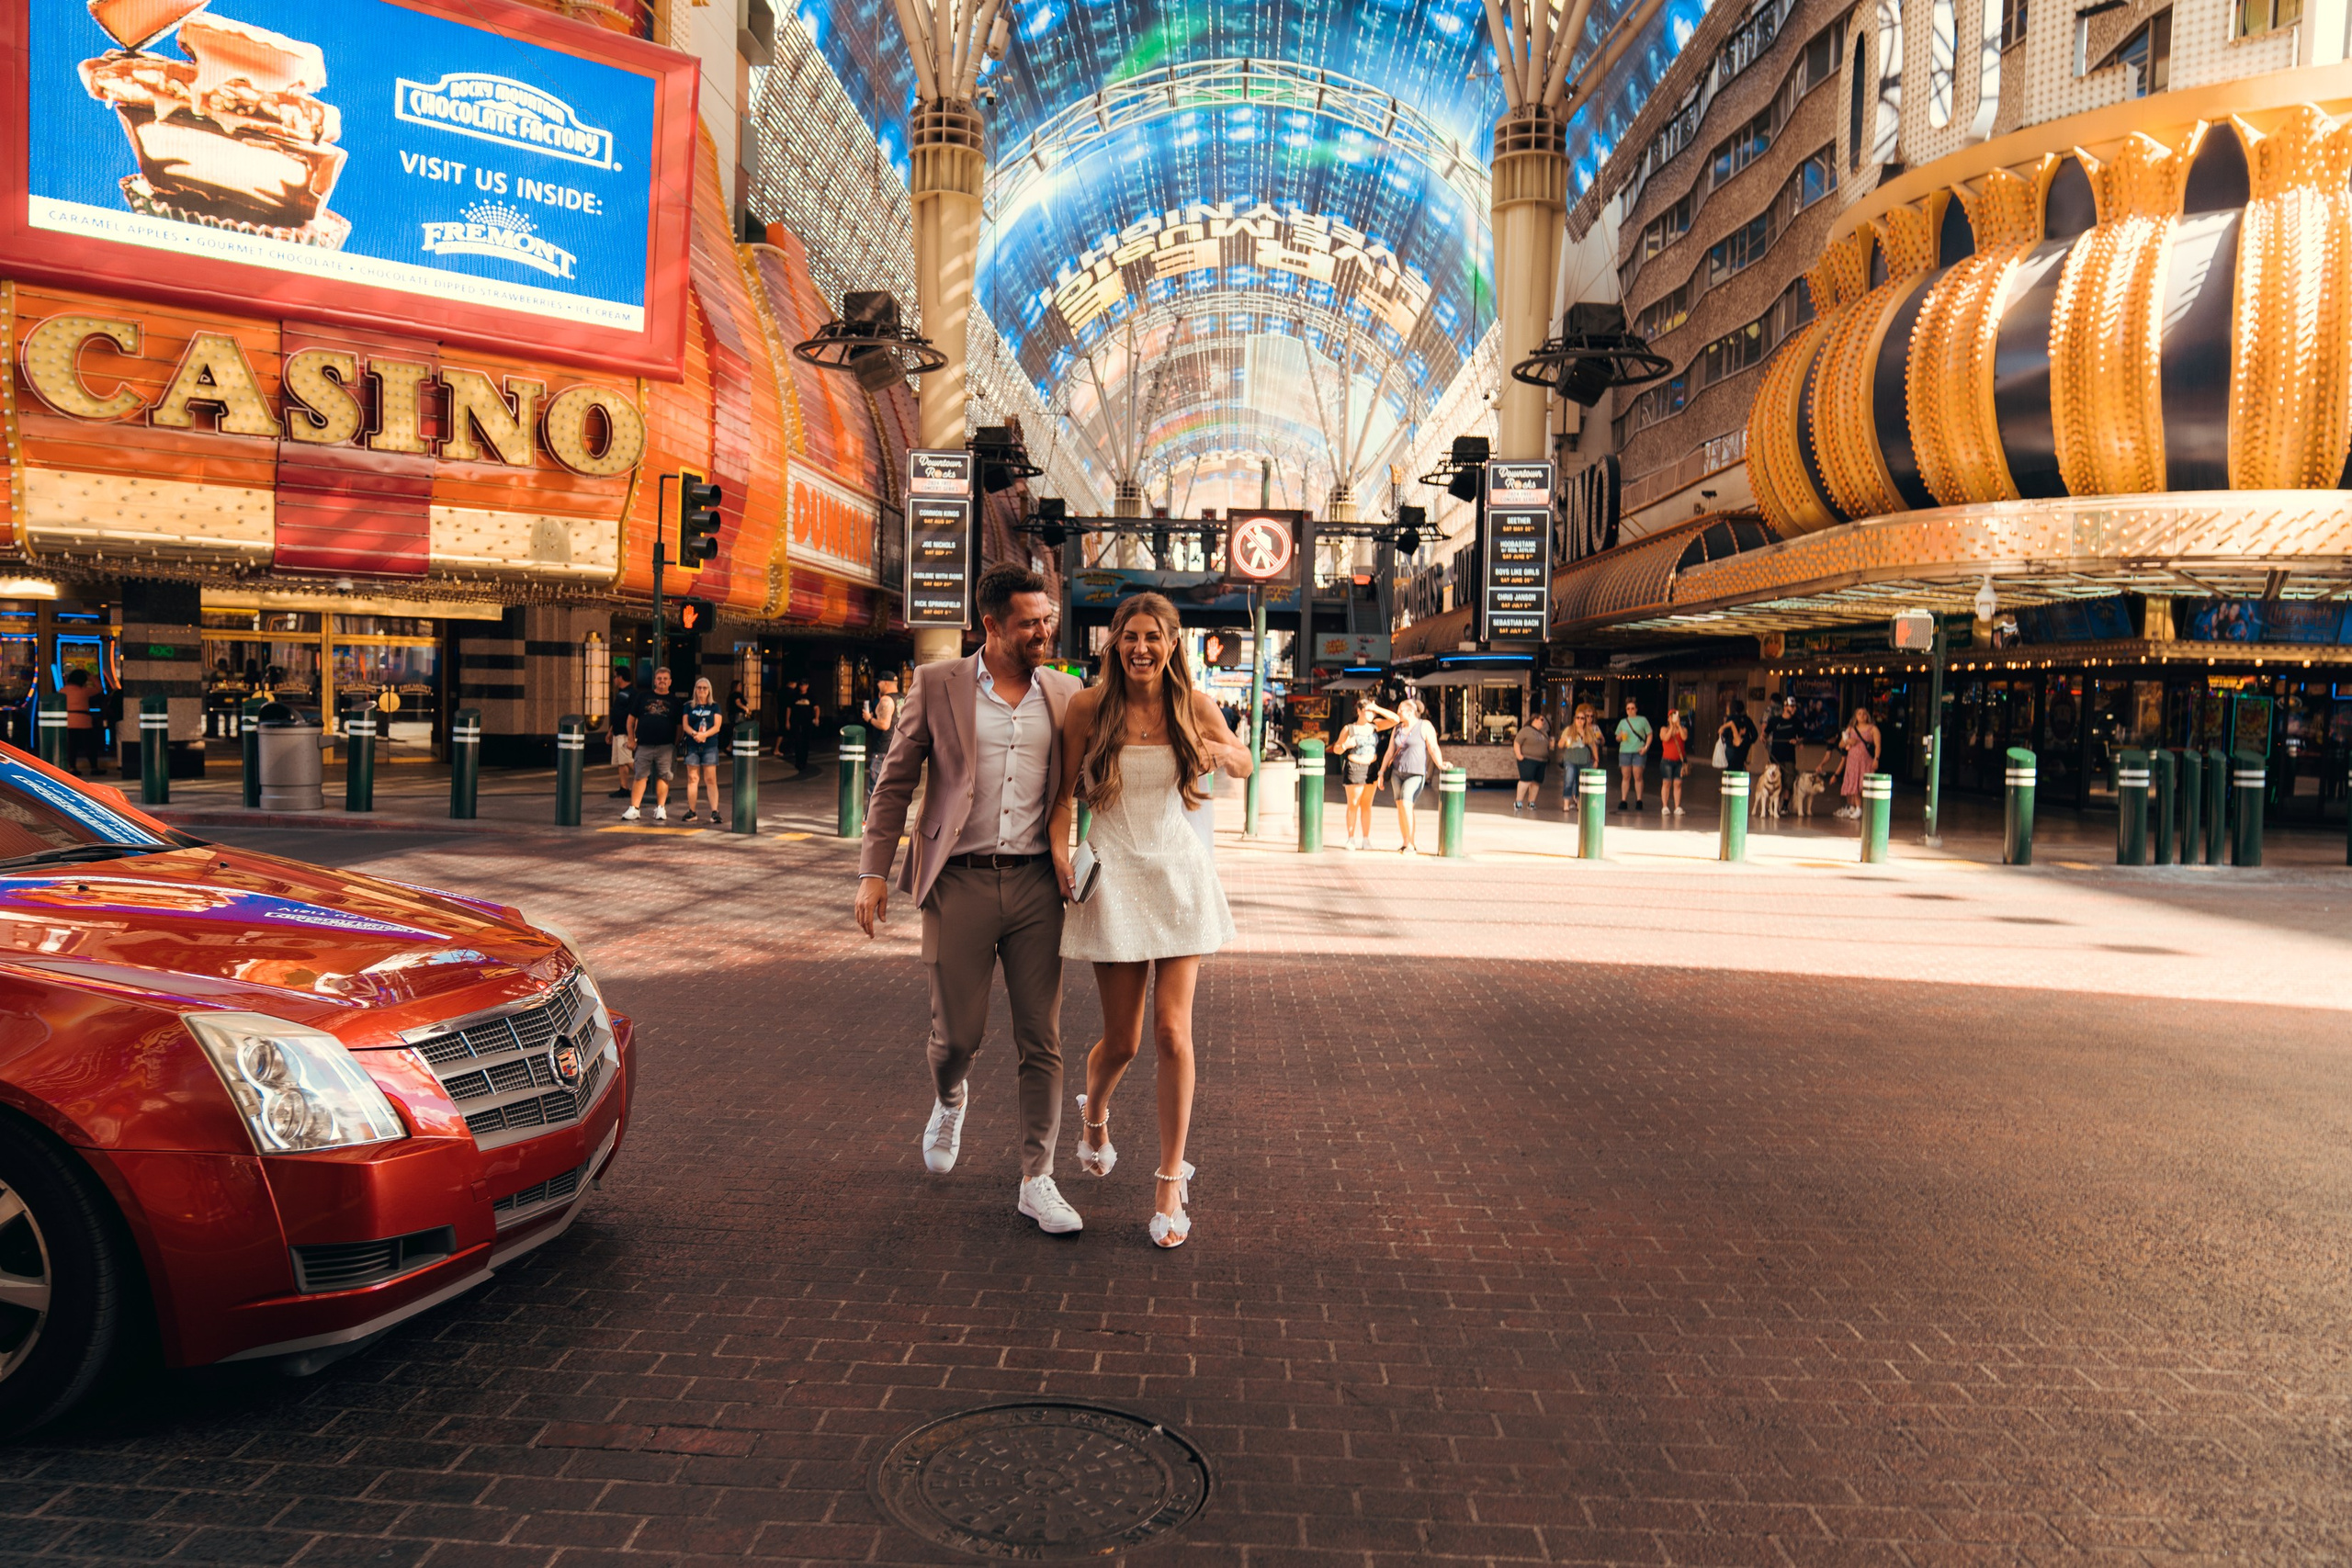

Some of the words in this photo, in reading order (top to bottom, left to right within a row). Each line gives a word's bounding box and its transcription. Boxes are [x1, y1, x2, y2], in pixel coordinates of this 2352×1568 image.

[450, 80, 493, 98] ROCKY
[495, 84, 565, 126] MOUNTAIN
[410, 90, 517, 136] CHOCOLATE
[520, 117, 599, 158] FACTORY
[399, 150, 467, 185] VISIT
[475, 167, 508, 195] US
[516, 177, 603, 216] INSIDE:
[422, 220, 577, 280] FREMONT
[48, 209, 120, 232] CARAMEL
[127, 223, 179, 242] APPLES
[196, 236, 265, 257] GOURMET
[268, 249, 344, 272] CHOCOLATE
[359, 265, 429, 287] CHOCOLATE
[434, 278, 476, 295] DIPPED
[480, 286, 563, 310] STRAWBERRIES
[575, 304, 592, 315] ICE
[594, 307, 632, 322] CREAM
[20, 312, 648, 479] CASINO
[919, 456, 963, 468] Downtown
[925, 467, 956, 479] Rocks
[1498, 467, 1544, 478] Downtown
[1504, 478, 1536, 490] Rocks
[1507, 516, 1531, 525] SEETHER
[1500, 540, 1536, 548] HOOBASTANK
[1495, 568, 1510, 576] BOYS
[1510, 568, 1522, 576] LIKE
[1523, 568, 1540, 576] GIRLS
[1497, 593, 1513, 602] CHRIS
[1514, 593, 1536, 602] JANSON
[928, 600, 961, 608] SPRINGFIELD
[1493, 618, 1522, 626] SEBASTIAN
